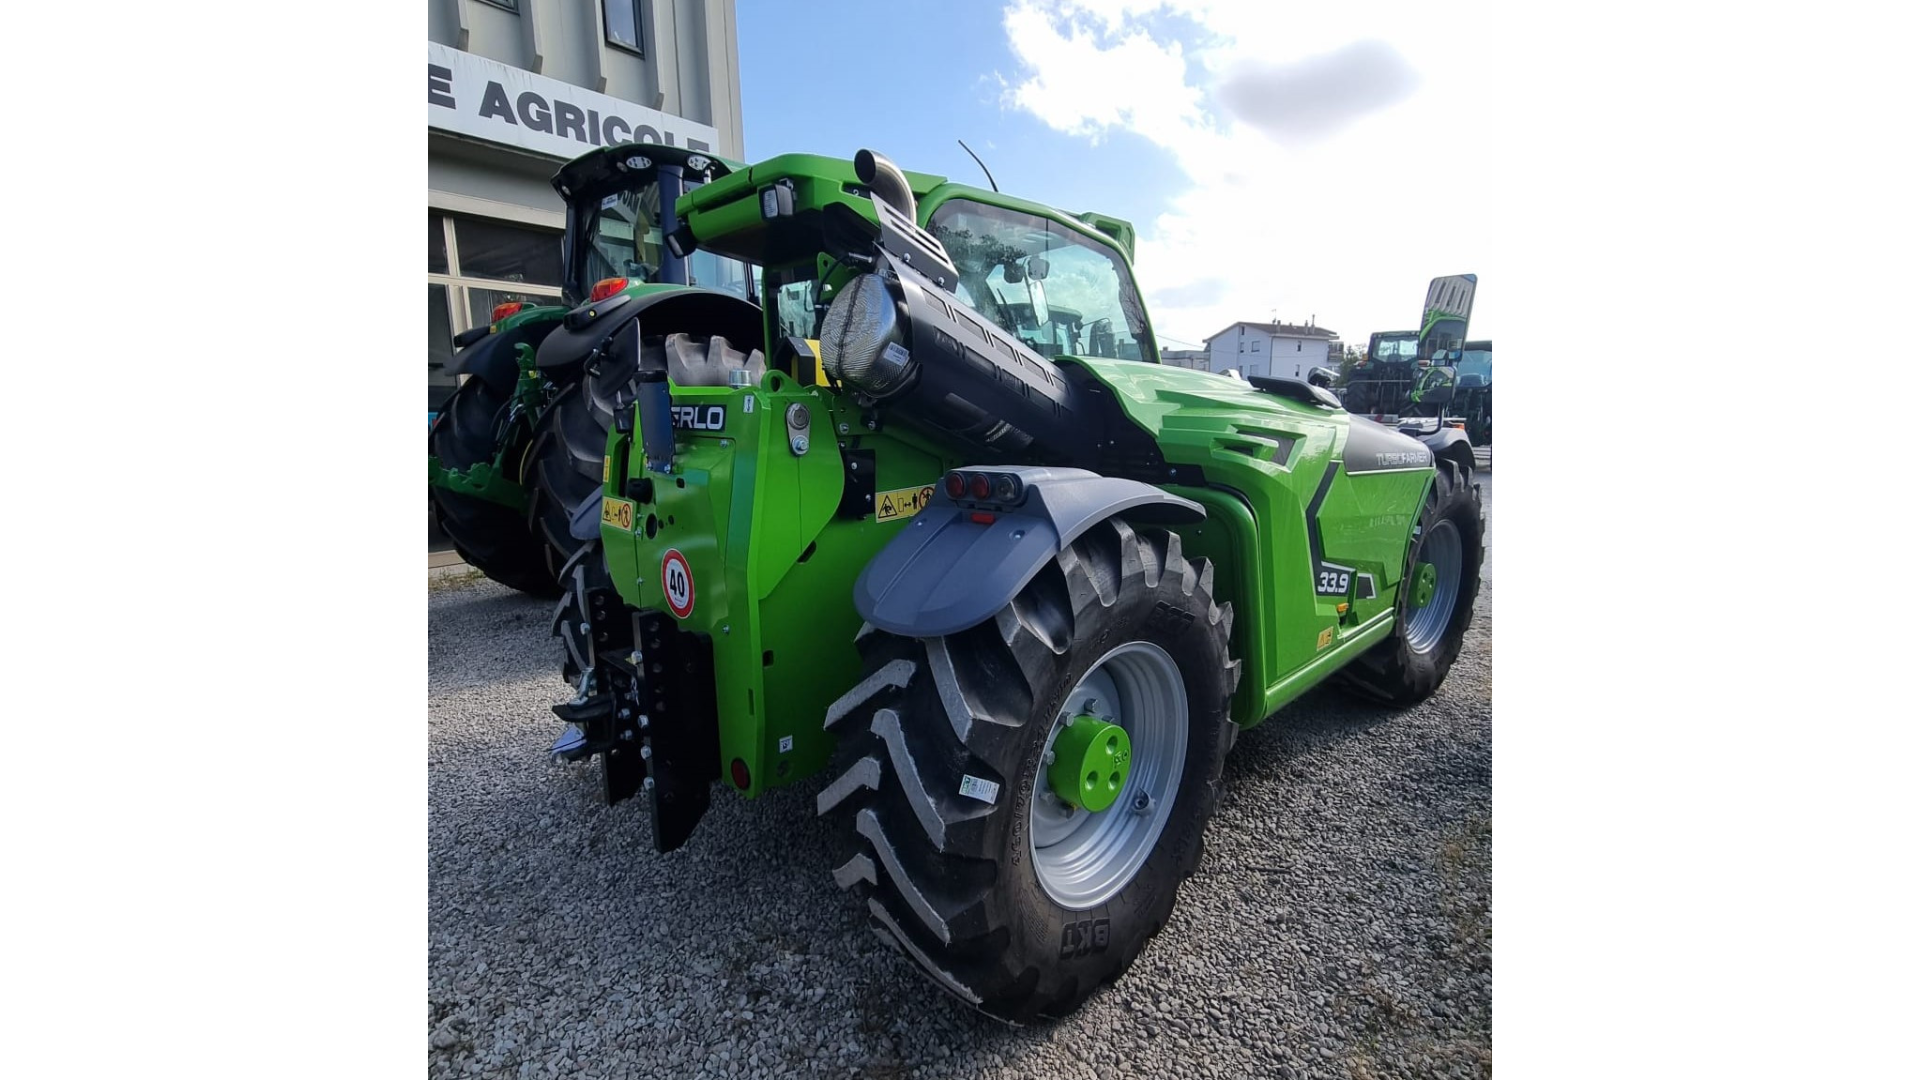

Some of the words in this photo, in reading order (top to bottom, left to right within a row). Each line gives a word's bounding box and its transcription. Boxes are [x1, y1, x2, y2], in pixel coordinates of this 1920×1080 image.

[669, 569, 685, 598] 40
[1317, 571, 1349, 593] 33.9
[1062, 922, 1109, 956] BKT
